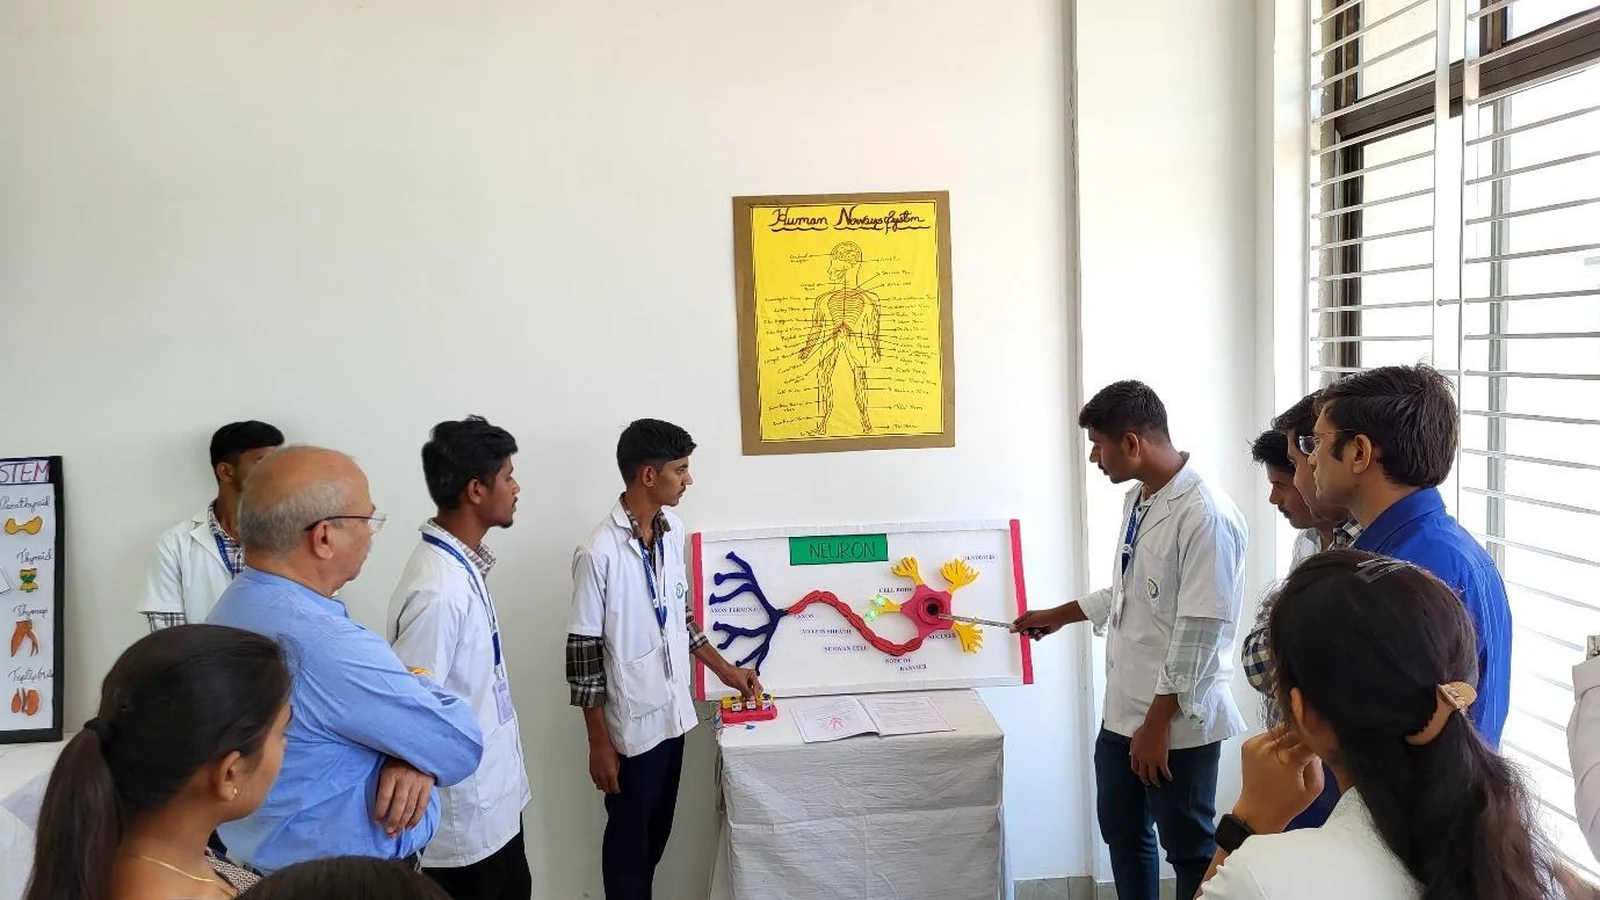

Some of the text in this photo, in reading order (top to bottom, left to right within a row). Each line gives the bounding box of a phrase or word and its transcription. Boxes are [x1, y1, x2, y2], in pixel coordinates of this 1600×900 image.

[768, 206, 829, 226] Human
[0, 462, 50, 482] STEM
[17, 548, 52, 565] Thyroid
[809, 540, 876, 560] NEURON
